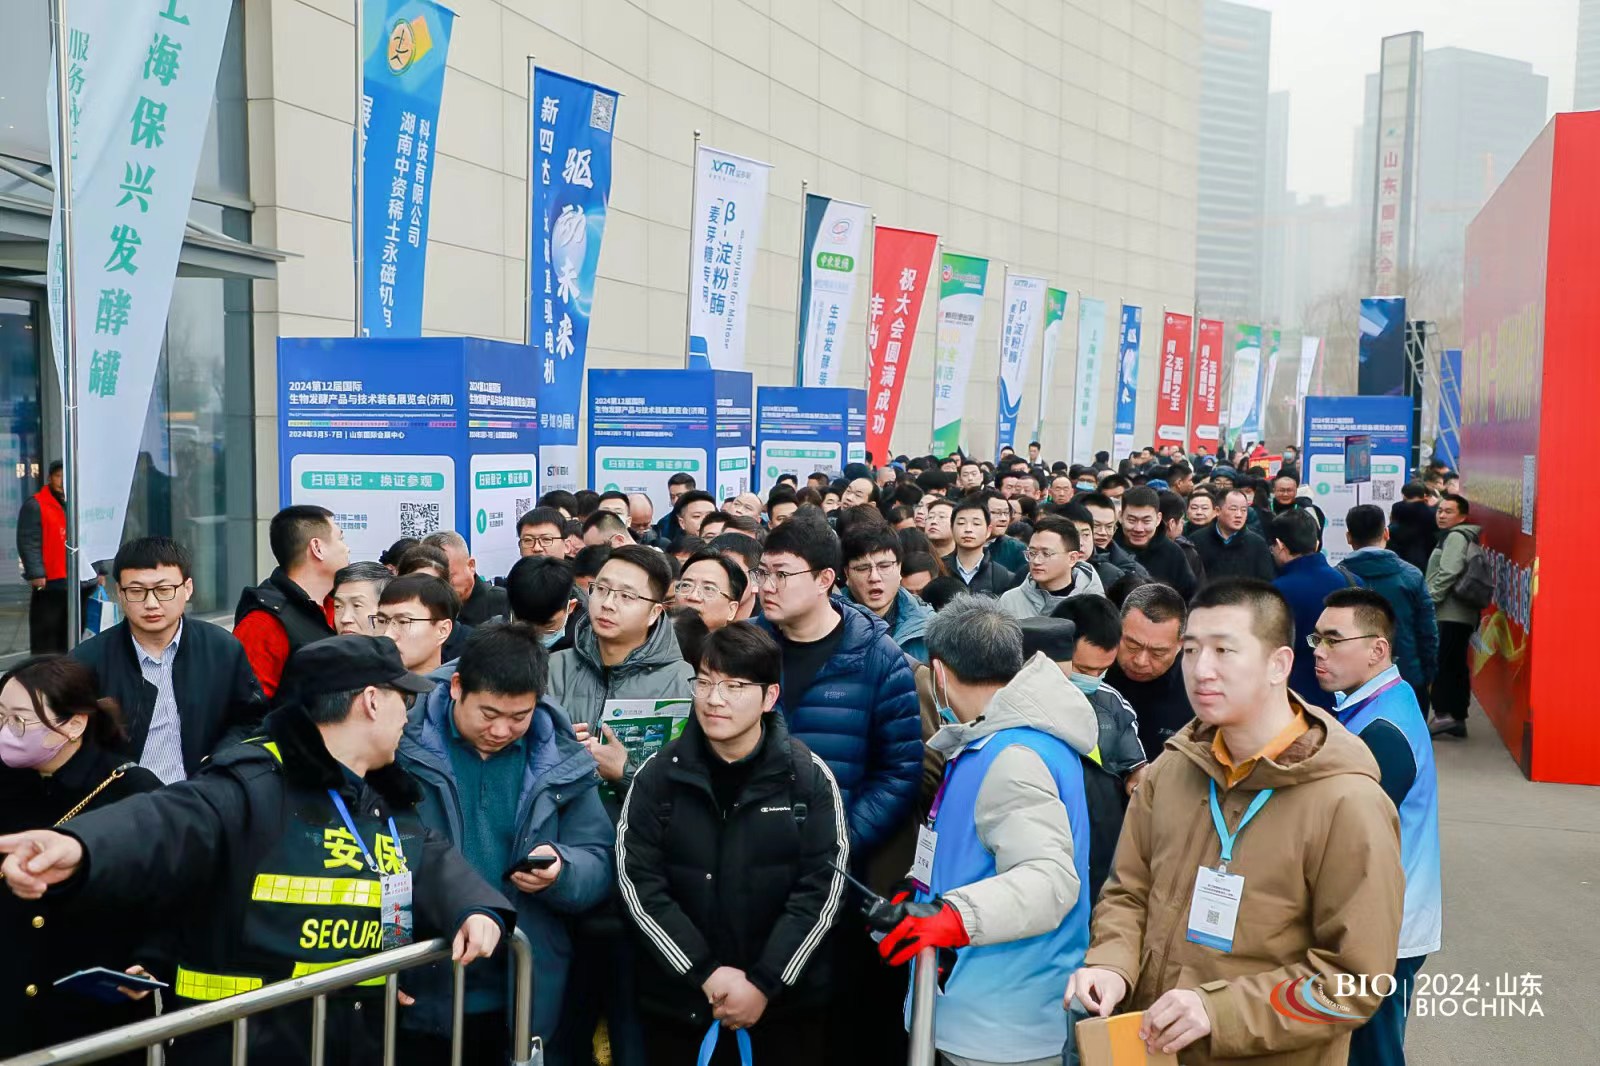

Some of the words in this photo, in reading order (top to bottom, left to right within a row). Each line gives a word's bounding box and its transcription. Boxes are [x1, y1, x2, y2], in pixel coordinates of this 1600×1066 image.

[407, 118, 430, 248] 科技有限公司
[872, 267, 918, 435] 祝大会圆满成功
[288, 381, 363, 392] 2024第12届国际
[289, 393, 454, 406] 生物发酵产品与技术装备展览会(济南)
[323, 826, 408, 875] 安保
